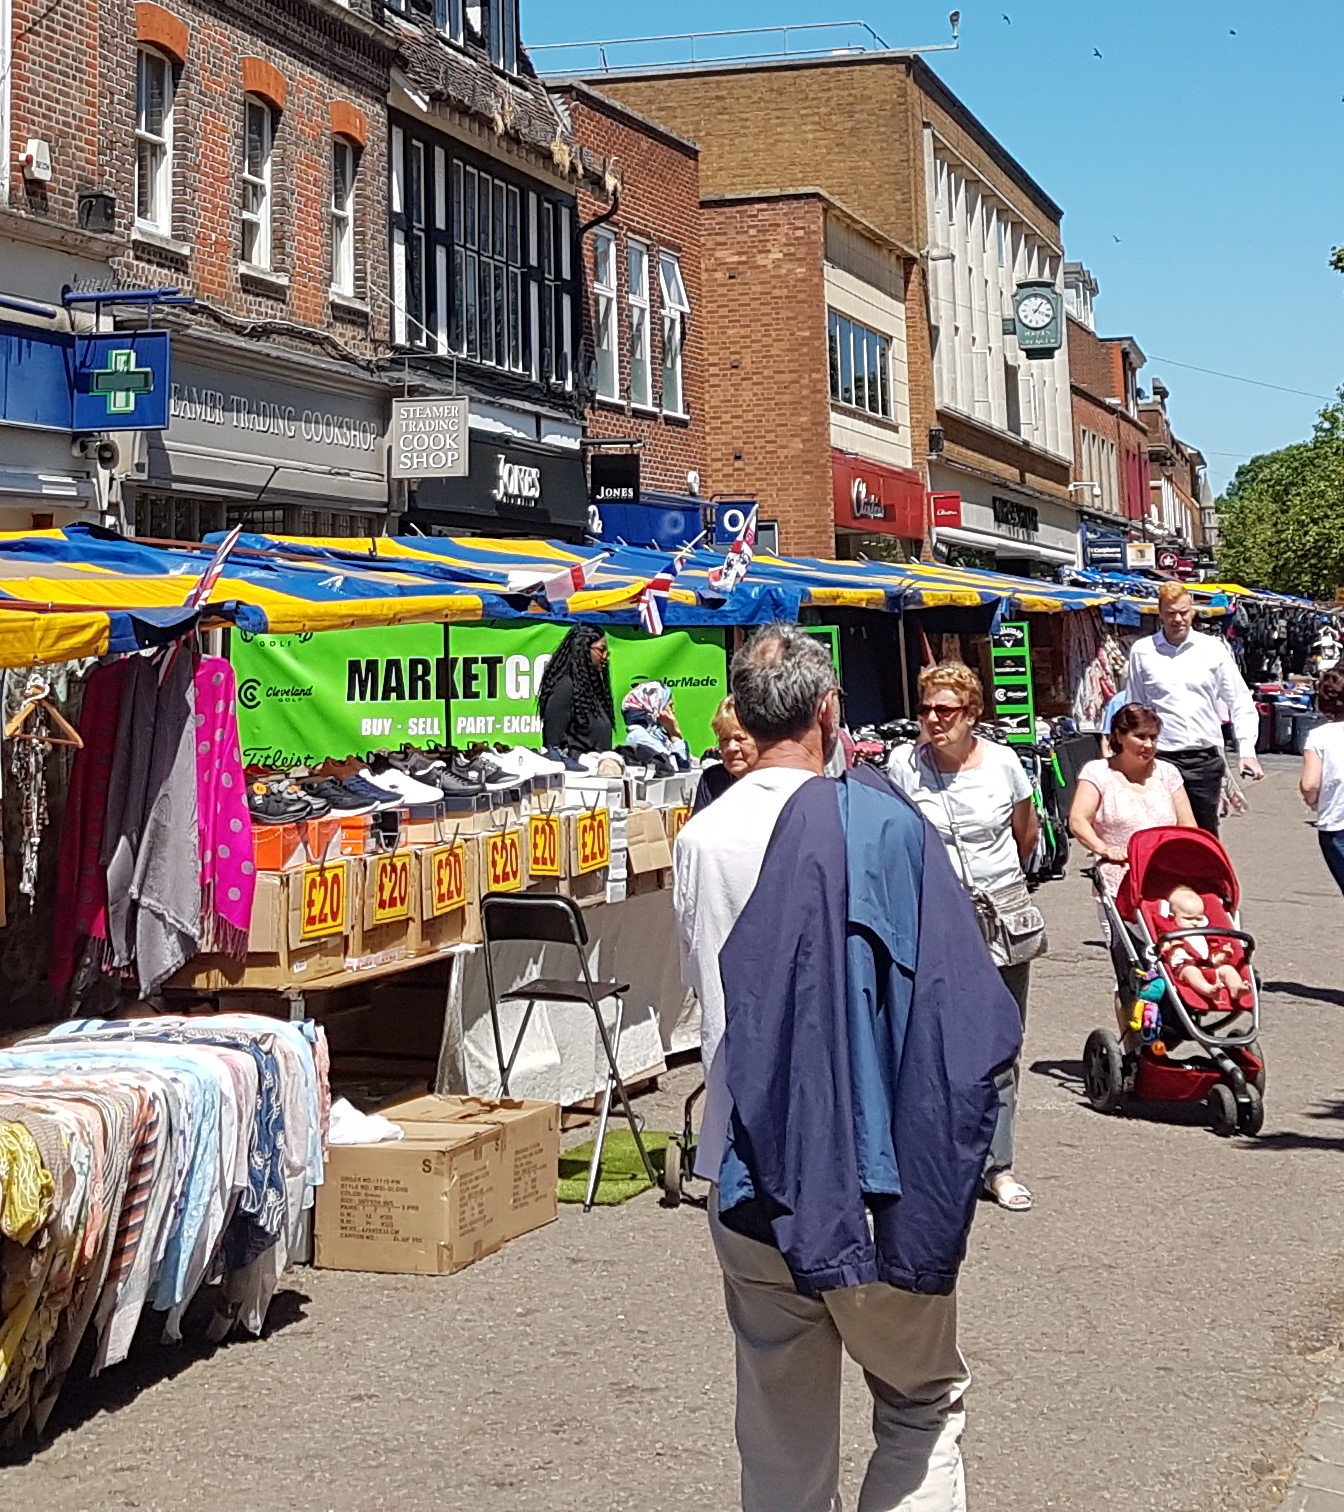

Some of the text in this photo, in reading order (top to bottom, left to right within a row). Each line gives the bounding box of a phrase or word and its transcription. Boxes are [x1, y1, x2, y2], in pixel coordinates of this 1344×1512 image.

[170, 382, 378, 452] EAMER TRADING COOKSHOP
[399, 405, 459, 419] STEAMER
[399, 419, 459, 433] TRADING
[399, 433, 459, 451] COOK
[399, 451, 459, 470] SHOP
[493, 454, 541, 500] JONES
[596, 486, 634, 499] JONES
[266, 685, 314, 698] Cleveland
[361, 718, 393, 736] BUY
[408, 717, 441, 735] SELL
[243, 745, 316, 770] Titleist
[533, 823, 557, 867] £20
[580, 815, 607, 864] £20
[491, 836, 519, 883] £20
[378, 857, 408, 911] £20
[437, 848, 464, 903] £20
[305, 871, 341, 927] £20
[422, 1158, 432, 1173] S
